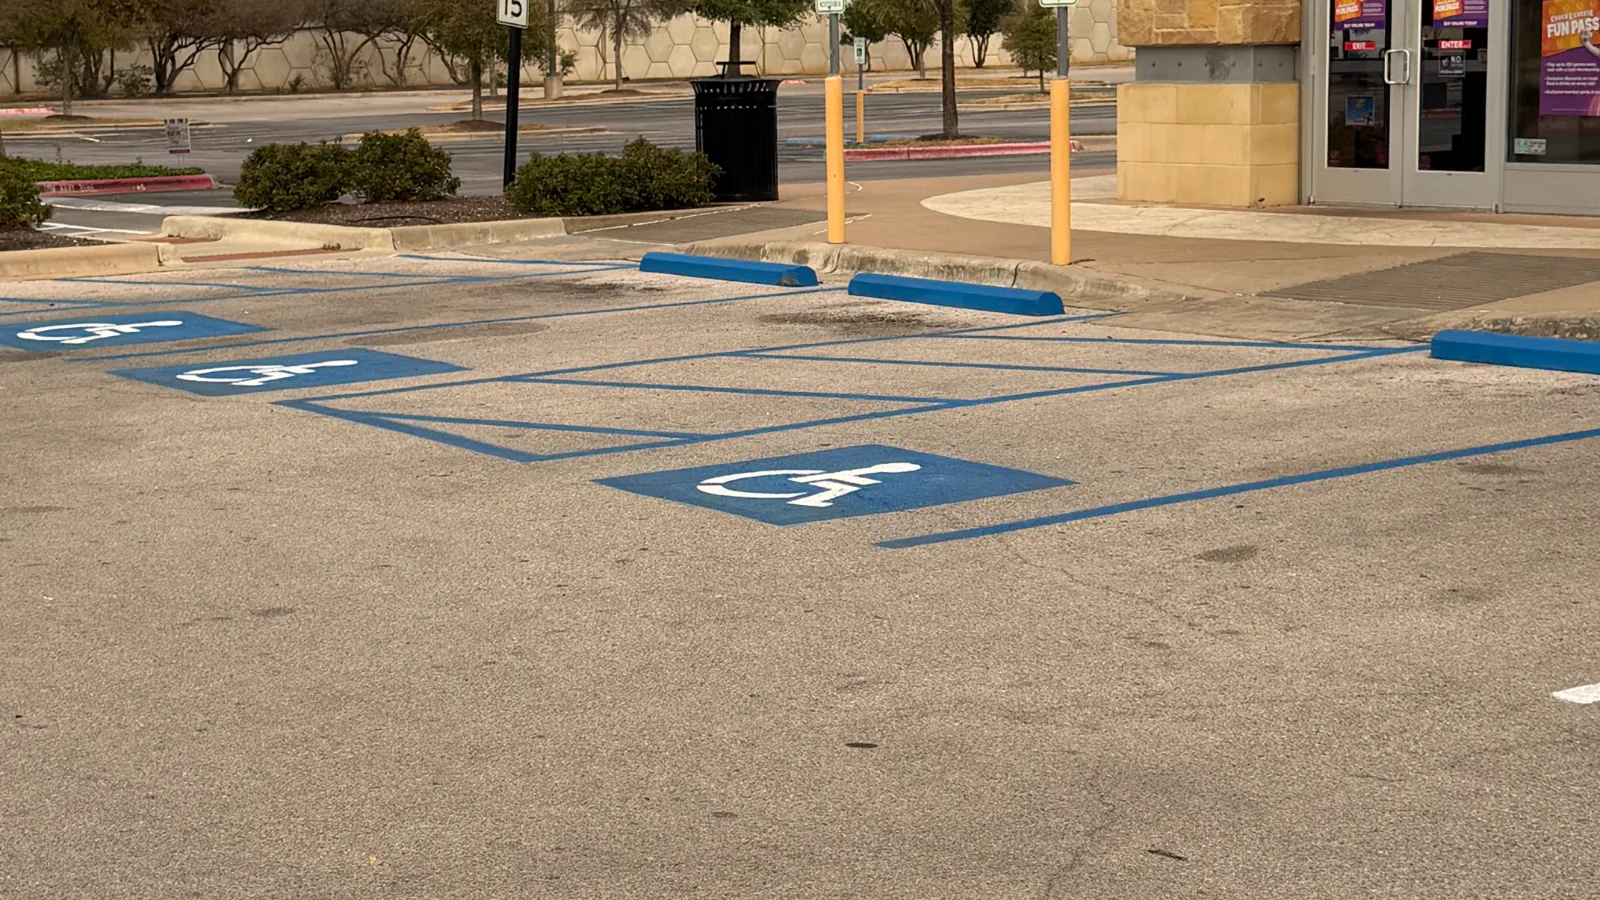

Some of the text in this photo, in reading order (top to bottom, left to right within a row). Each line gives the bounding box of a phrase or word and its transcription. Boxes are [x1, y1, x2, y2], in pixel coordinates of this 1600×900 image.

[505, 0, 522, 17] 15
[1547, 17, 1600, 38] FUN PASS
[1352, 42, 1366, 50] EXIT
[1441, 40, 1463, 49] ENTER
